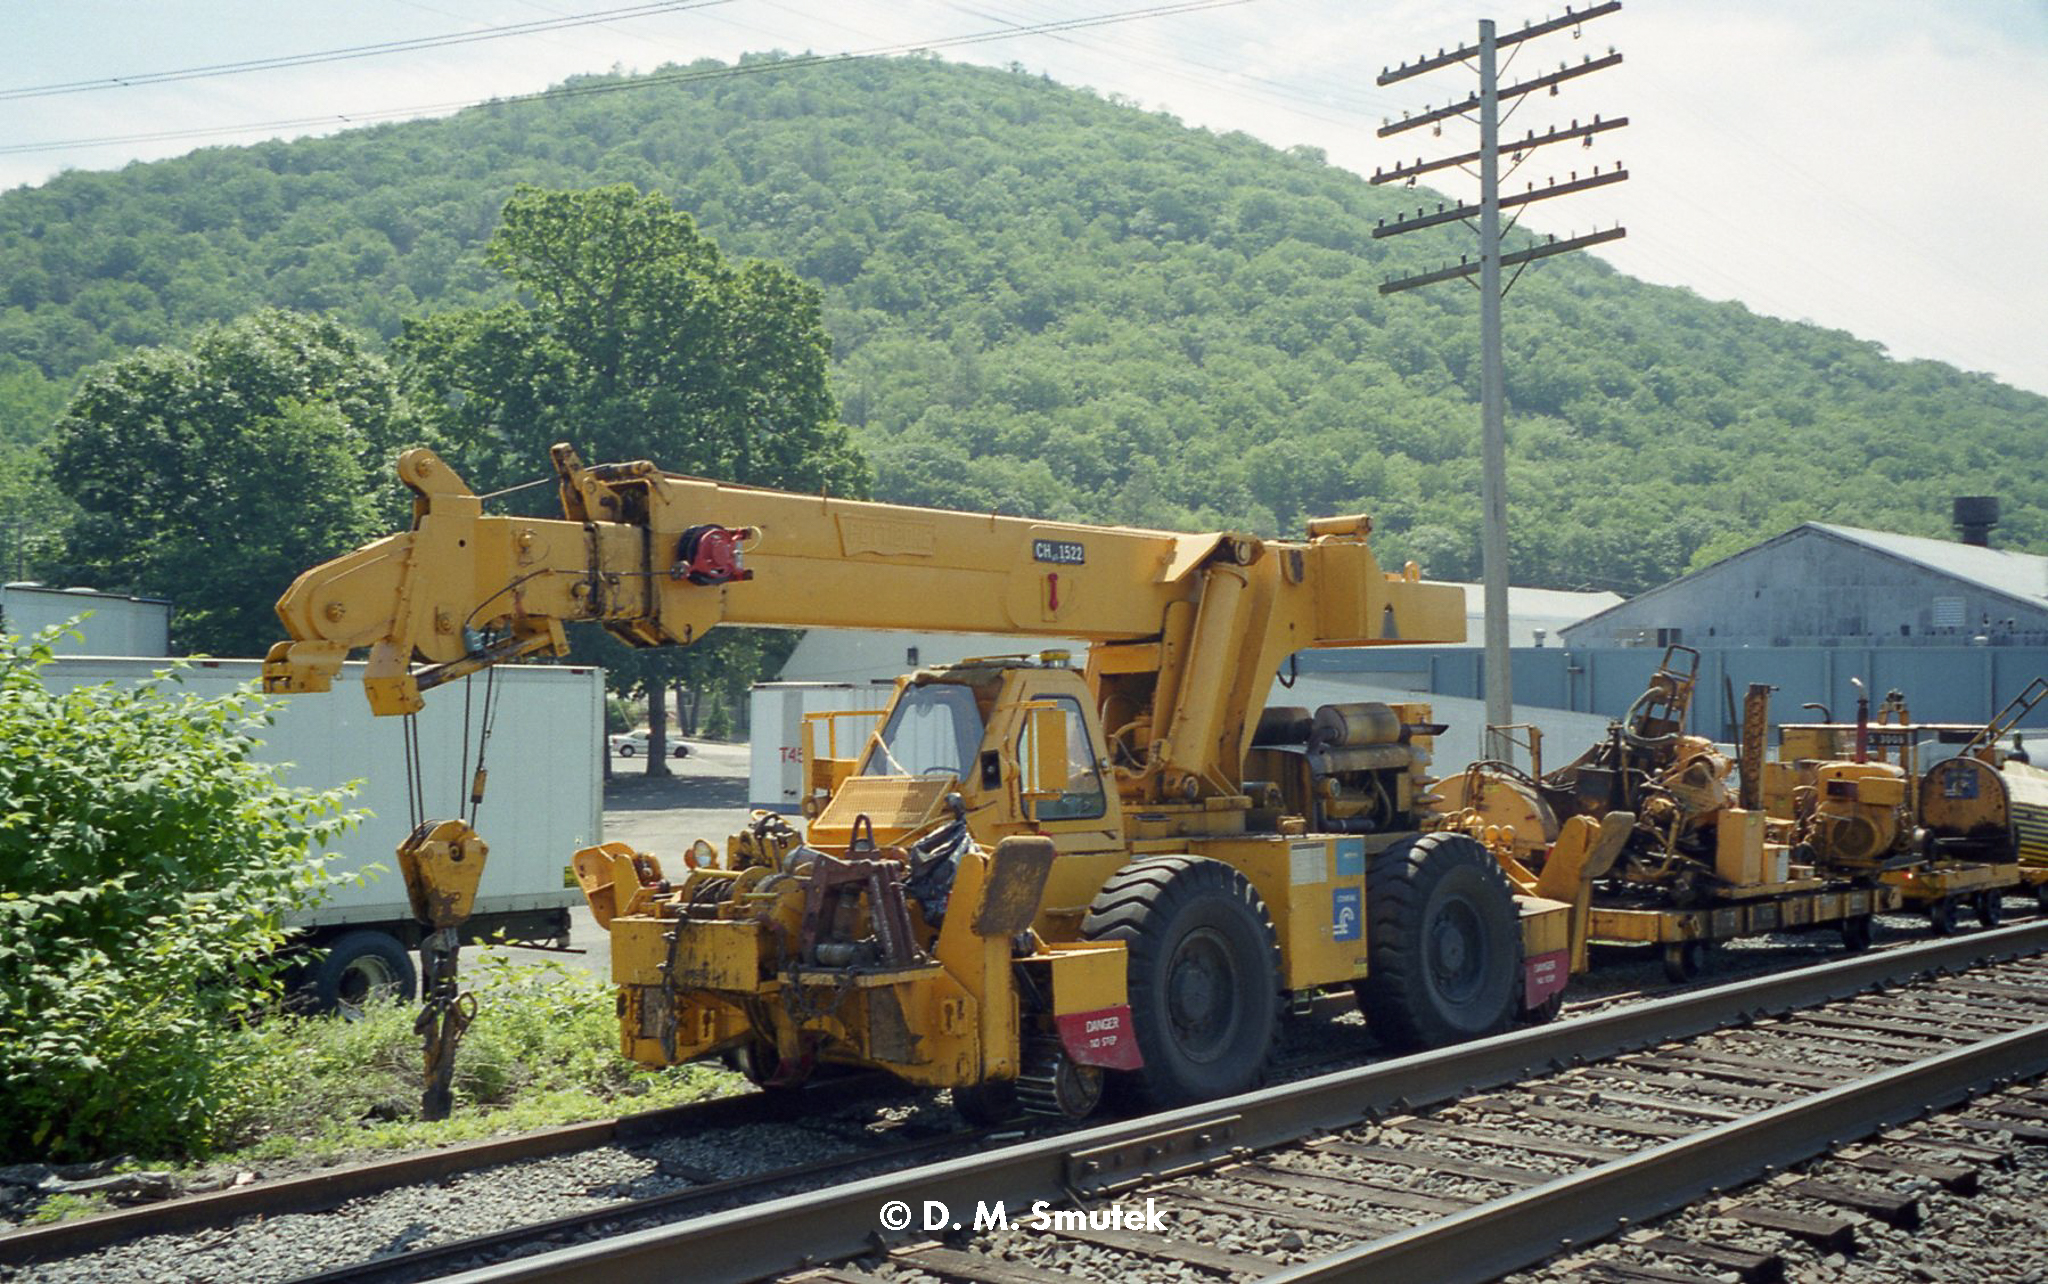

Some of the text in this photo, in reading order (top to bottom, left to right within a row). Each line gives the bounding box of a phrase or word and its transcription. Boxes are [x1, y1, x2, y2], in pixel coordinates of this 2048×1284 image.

[1059, 544, 1083, 561] 1522
[1086, 1016, 1119, 1033] DANGER
[1089, 1035, 1118, 1048] NO STEP
